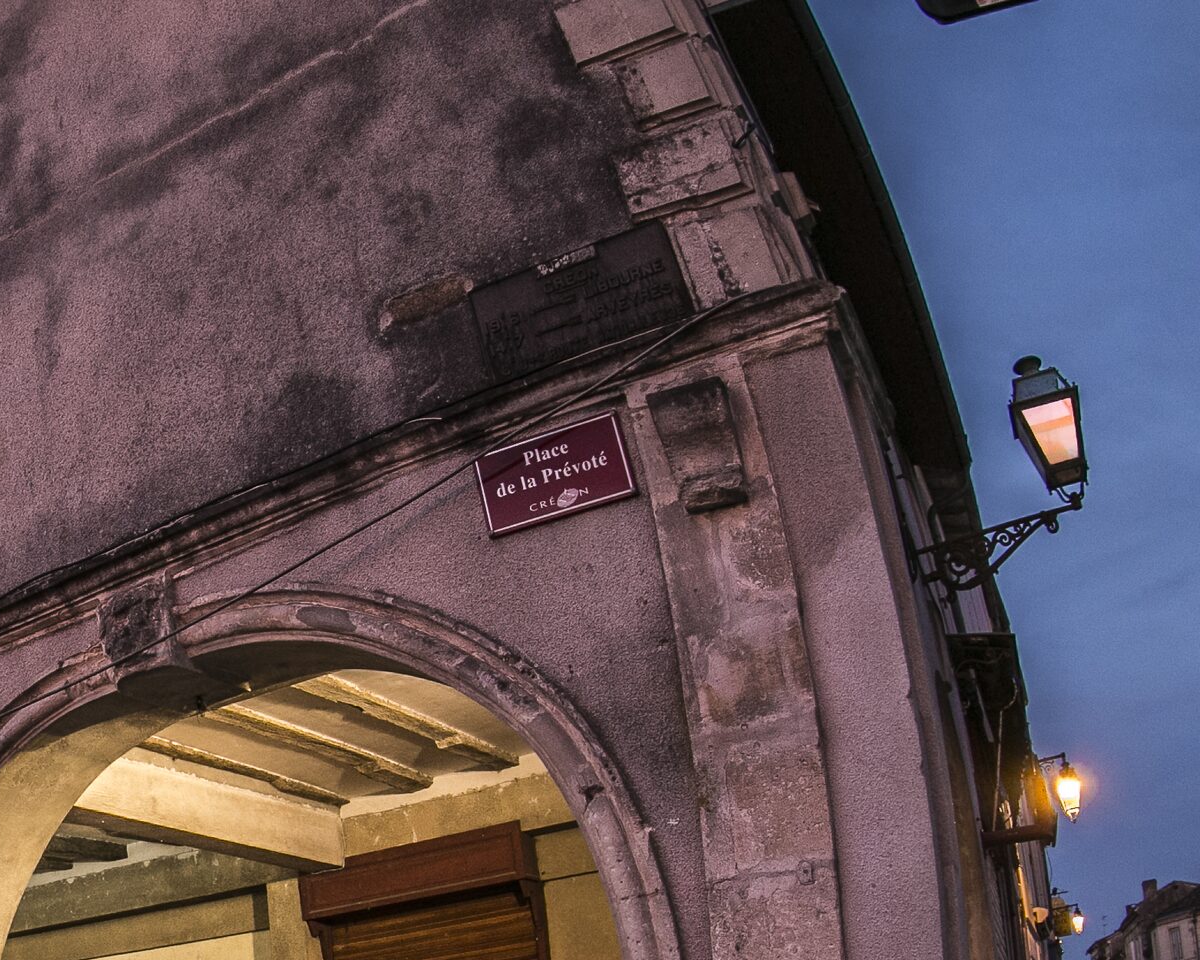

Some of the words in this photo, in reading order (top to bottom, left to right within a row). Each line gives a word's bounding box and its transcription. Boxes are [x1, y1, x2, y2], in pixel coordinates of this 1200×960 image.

[582, 260, 665, 299] LIBOURNE
[584, 282, 672, 323] ARVEYRES
[496, 482, 516, 499] de
[520, 476, 537, 491] la
[541, 450, 608, 484] Prévoté
[522, 443, 569, 467] Place
